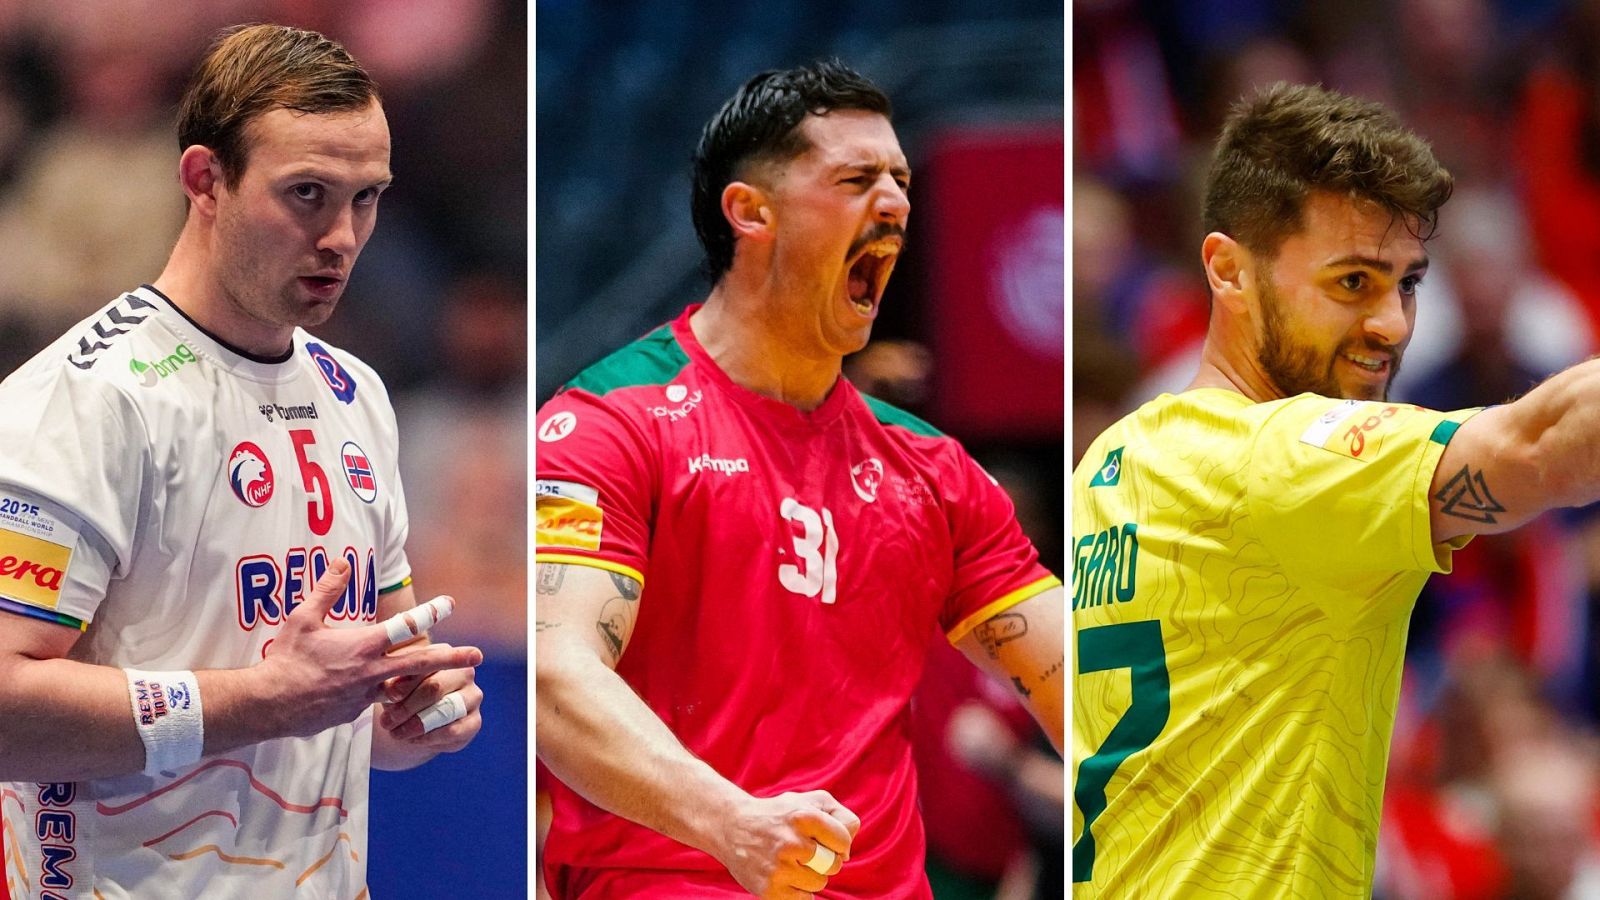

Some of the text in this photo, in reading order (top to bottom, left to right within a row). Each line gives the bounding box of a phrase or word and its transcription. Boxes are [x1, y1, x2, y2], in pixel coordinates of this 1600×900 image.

[273, 402, 318, 420] hummel
[288, 429, 334, 536] 5
[688, 453, 750, 476] Kempa
[0, 498, 40, 516] 2025
[254, 483, 272, 500] NHF
[31, 521, 54, 532] WORLD
[778, 498, 839, 604] 31
[1073, 522, 1138, 612] GARO
[134, 680, 155, 726] REMA
[149, 683, 168, 719] 1000
[1072, 619, 1170, 883] 7
